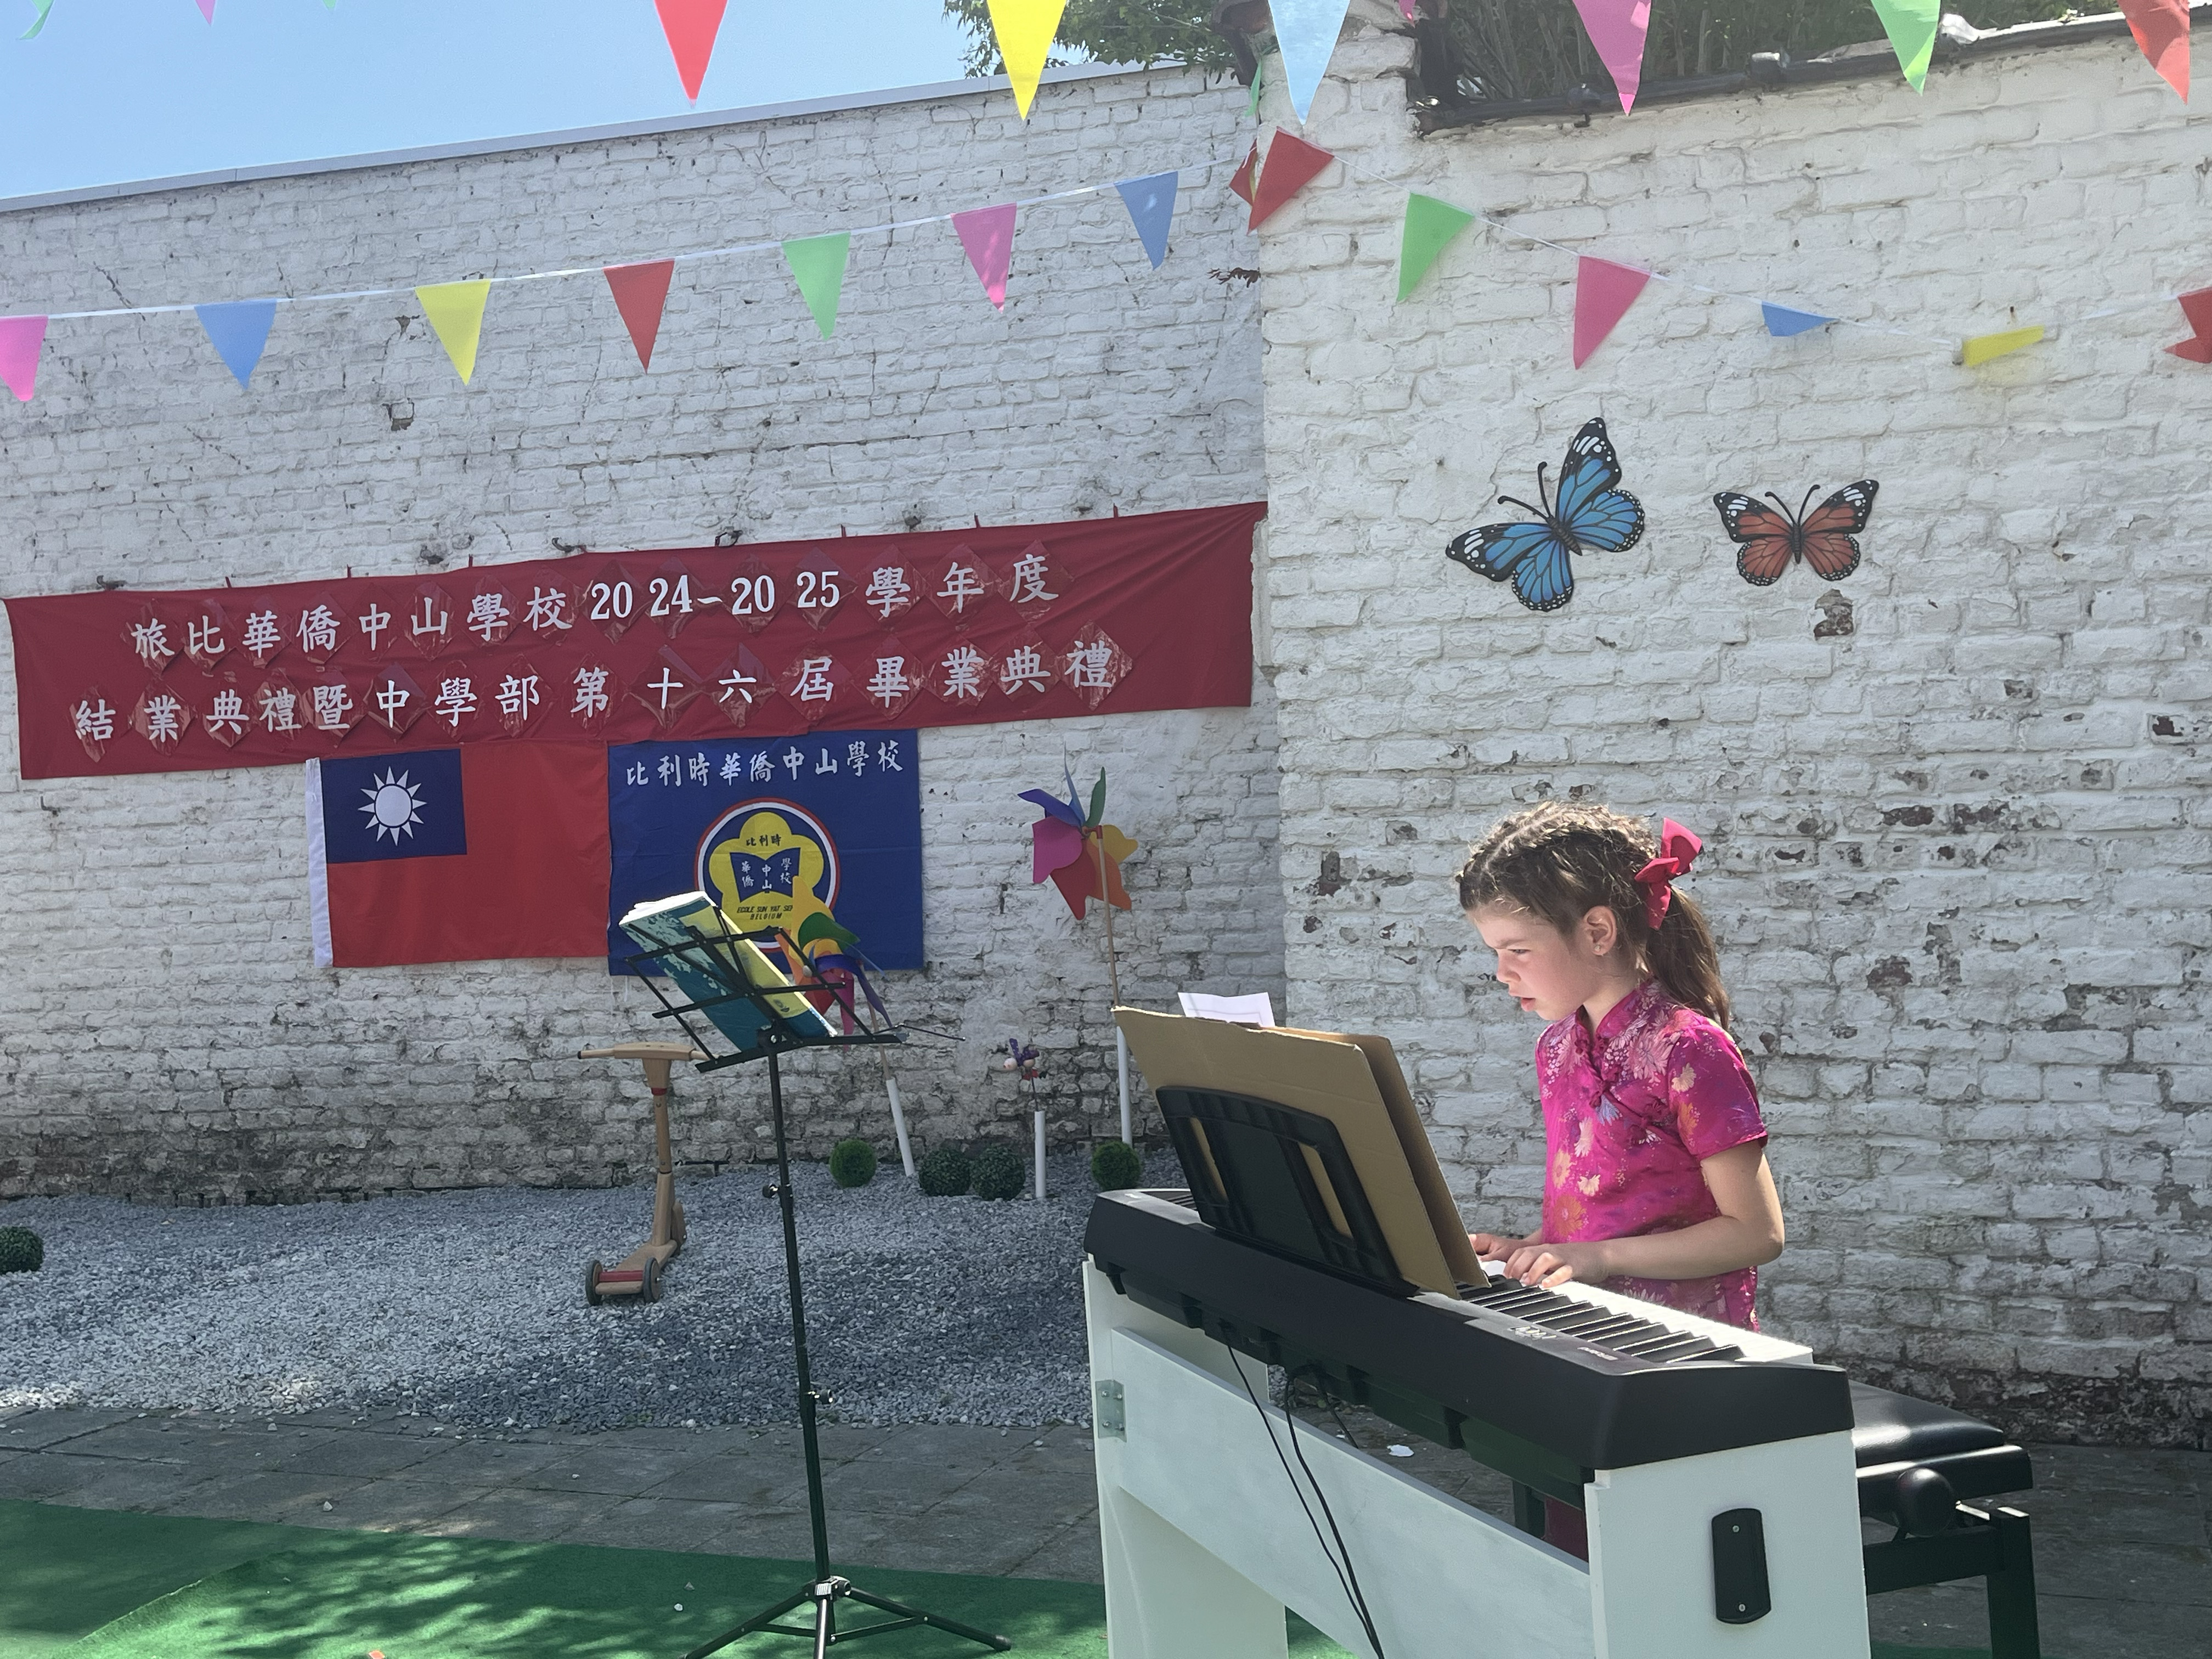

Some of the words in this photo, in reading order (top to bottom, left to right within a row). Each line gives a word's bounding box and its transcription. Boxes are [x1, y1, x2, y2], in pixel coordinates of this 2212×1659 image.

[626, 740, 904, 787] 比利時華僑中山學校
[746, 834, 781, 846] 比利時
